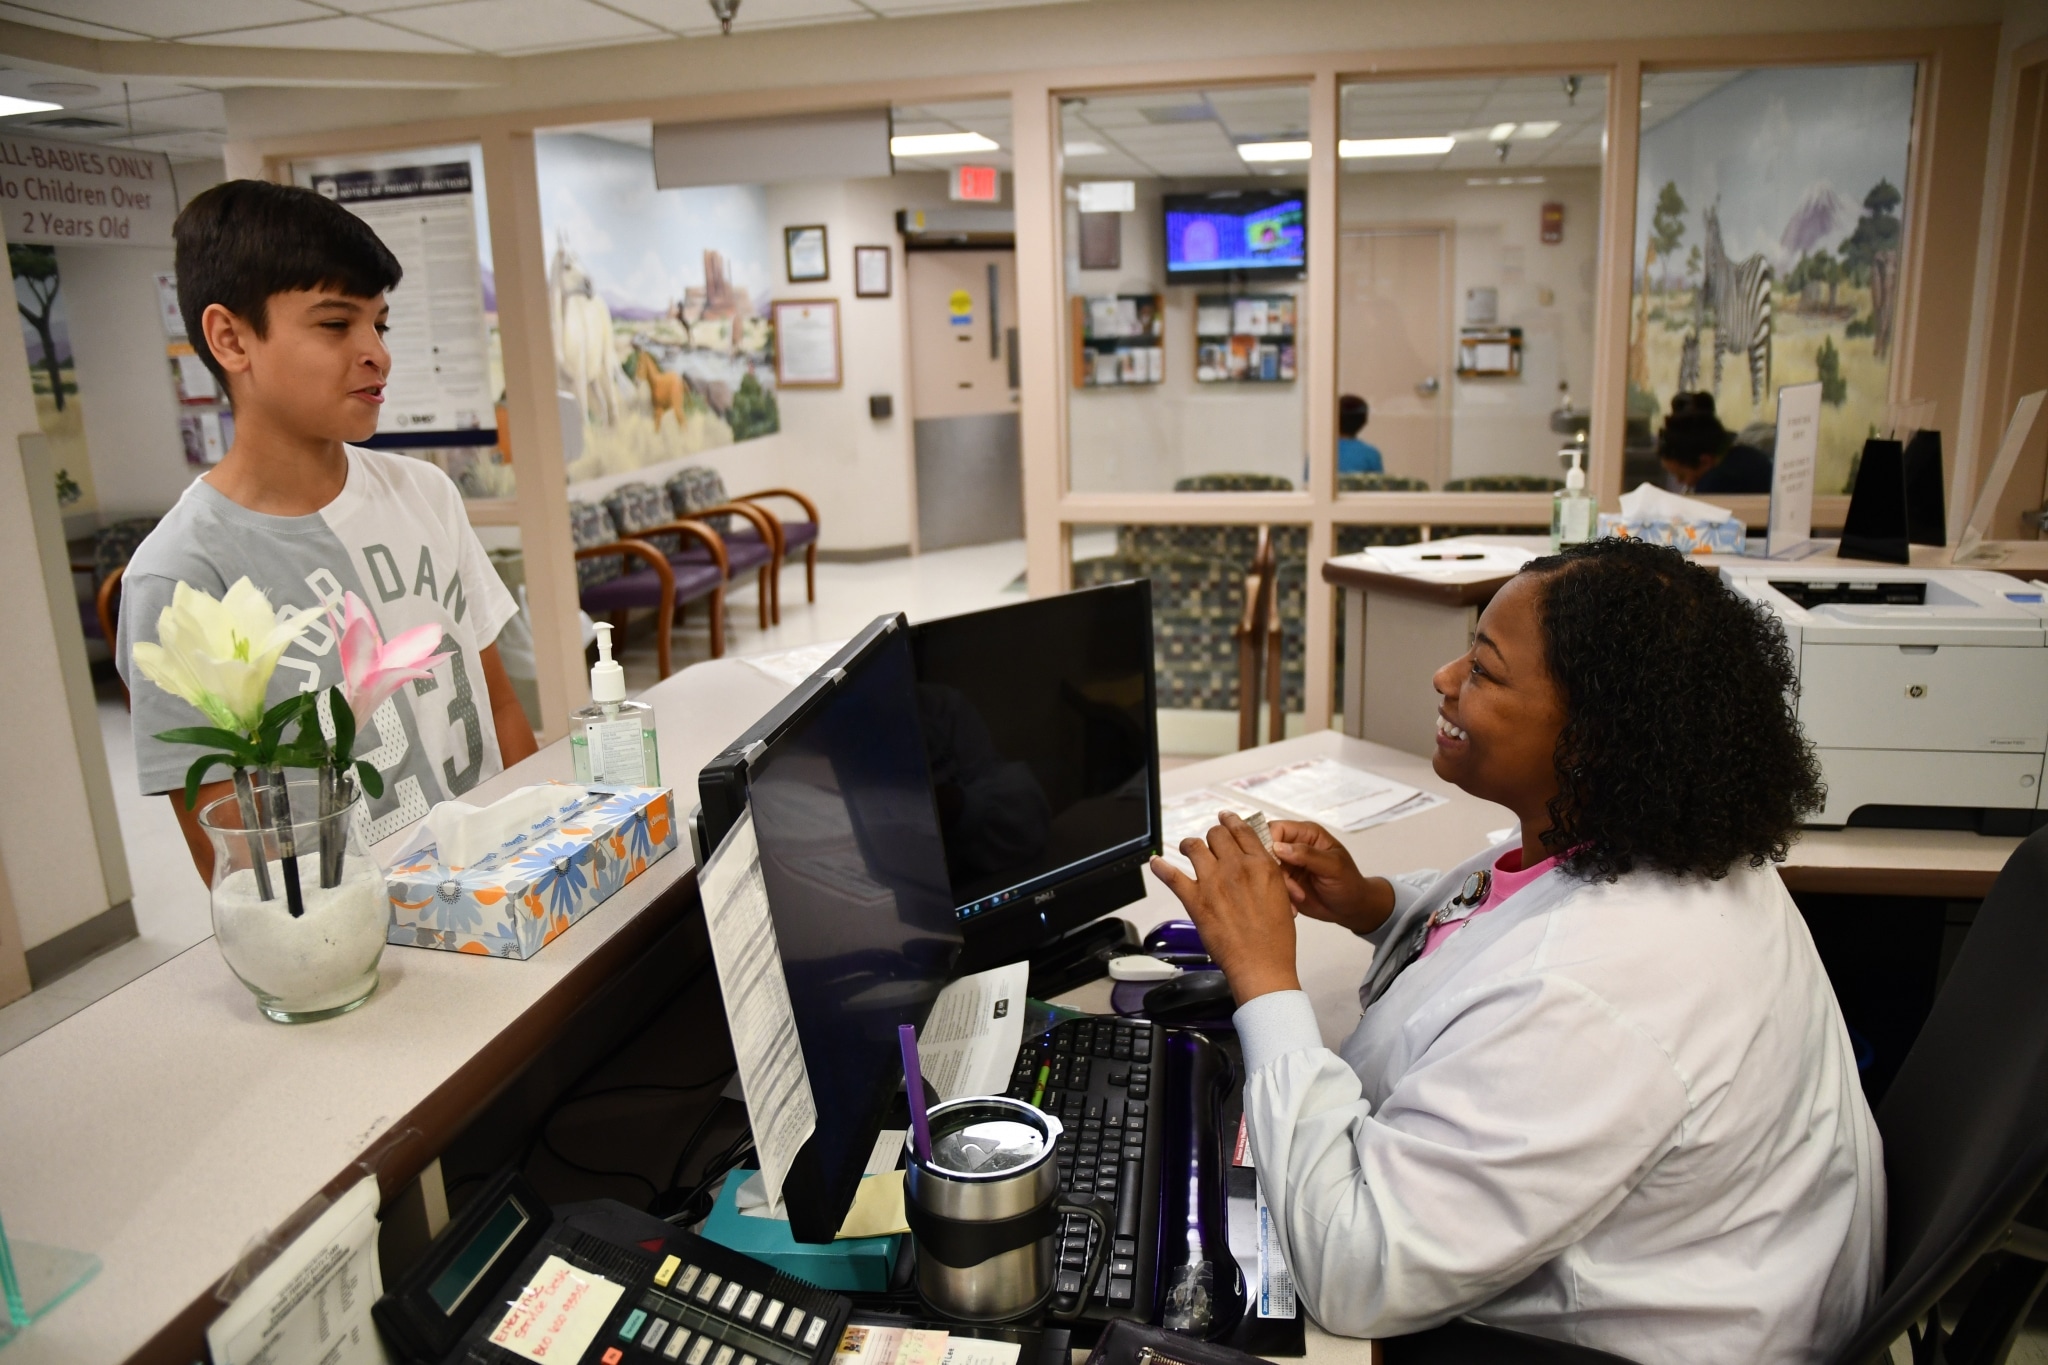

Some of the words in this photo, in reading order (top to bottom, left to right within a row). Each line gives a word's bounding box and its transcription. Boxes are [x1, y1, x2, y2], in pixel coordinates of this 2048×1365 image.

[0, 142, 104, 175] LL-BABIES
[108, 156, 154, 180] ONLY
[24, 177, 107, 207] Children
[111, 185, 151, 210] Over
[23, 212, 34, 234] 2
[40, 212, 93, 237] Years
[99, 216, 129, 239] Old
[277, 543, 467, 692] JORDAN
[317, 633, 484, 847] 23
[1034, 890, 1056, 904] DELL
[495, 1285, 545, 1343] Enterprise
[514, 1301, 546, 1338] Service
[545, 1270, 570, 1295] Desk
